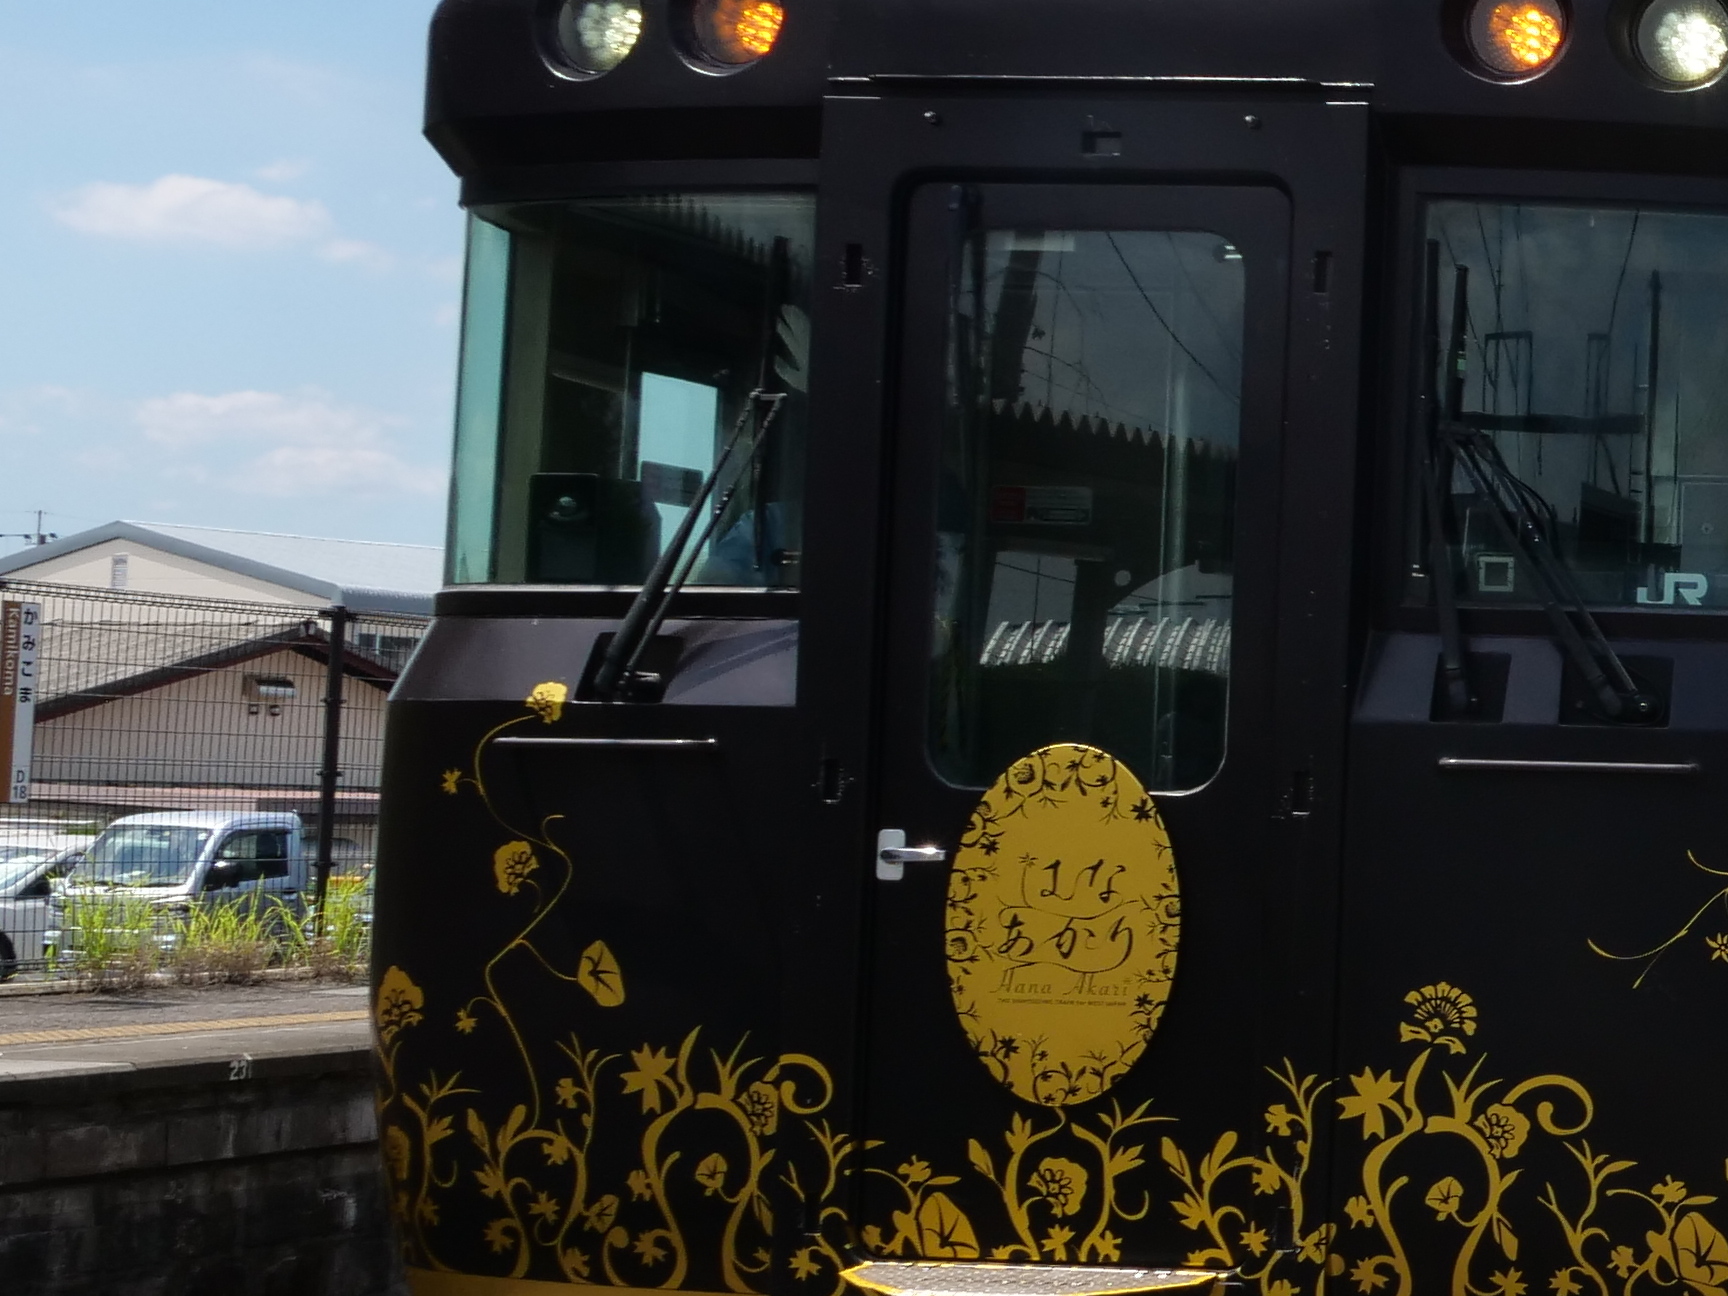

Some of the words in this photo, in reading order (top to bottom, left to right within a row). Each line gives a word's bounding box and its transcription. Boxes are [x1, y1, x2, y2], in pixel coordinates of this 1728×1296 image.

[1637, 572, 1708, 605] JR
[4, 608, 20, 695] Kamikoma
[20, 608, 38, 703] かみこま
[13, 785, 27, 800] 18
[17, 770, 25, 783] D
[1019, 853, 1127, 907] はな
[998, 913, 1133, 968] あかり
